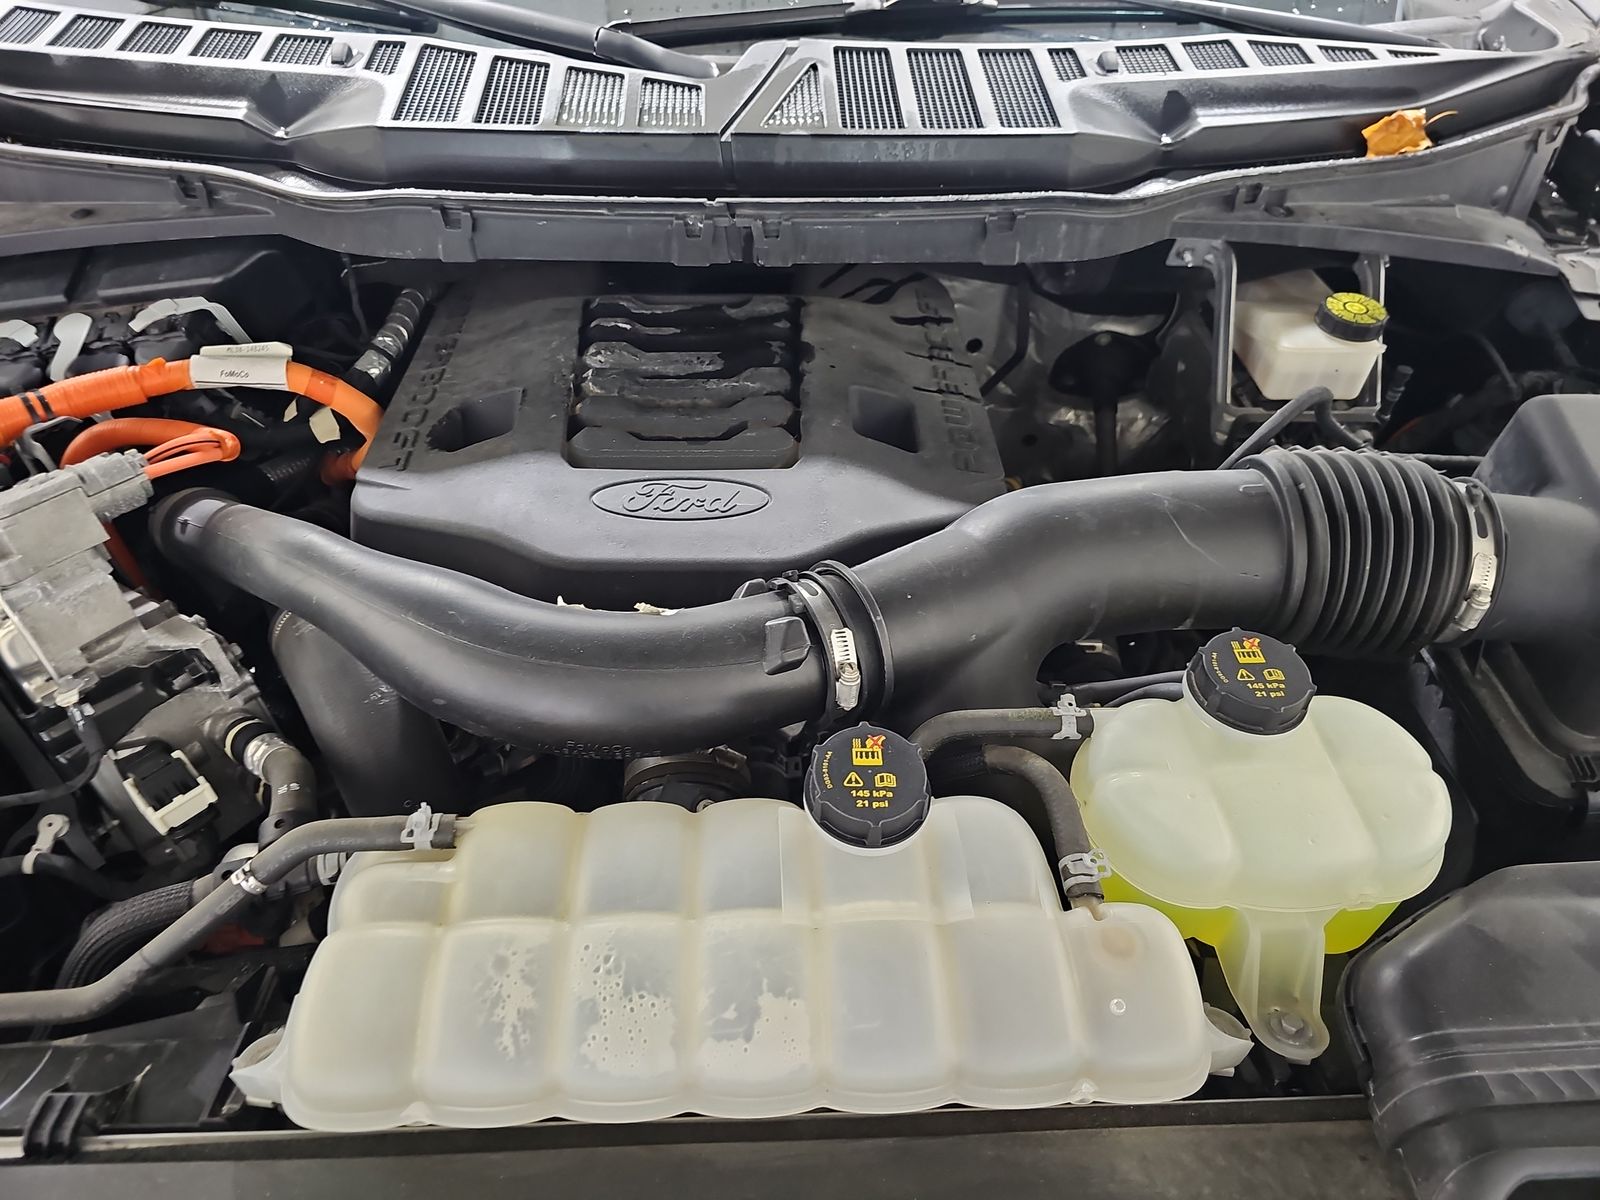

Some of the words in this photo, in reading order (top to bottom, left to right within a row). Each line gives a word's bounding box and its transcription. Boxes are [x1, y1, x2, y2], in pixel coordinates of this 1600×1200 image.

[220, 369, 250, 379] FoMoCo
[623, 482, 740, 514] Ford
[1266, 682, 1286, 690] kPa
[1269, 690, 1285, 699] psi
[850, 790, 870, 798] 145
[872, 790, 894, 798] kPa
[872, 800, 889, 809] psi
